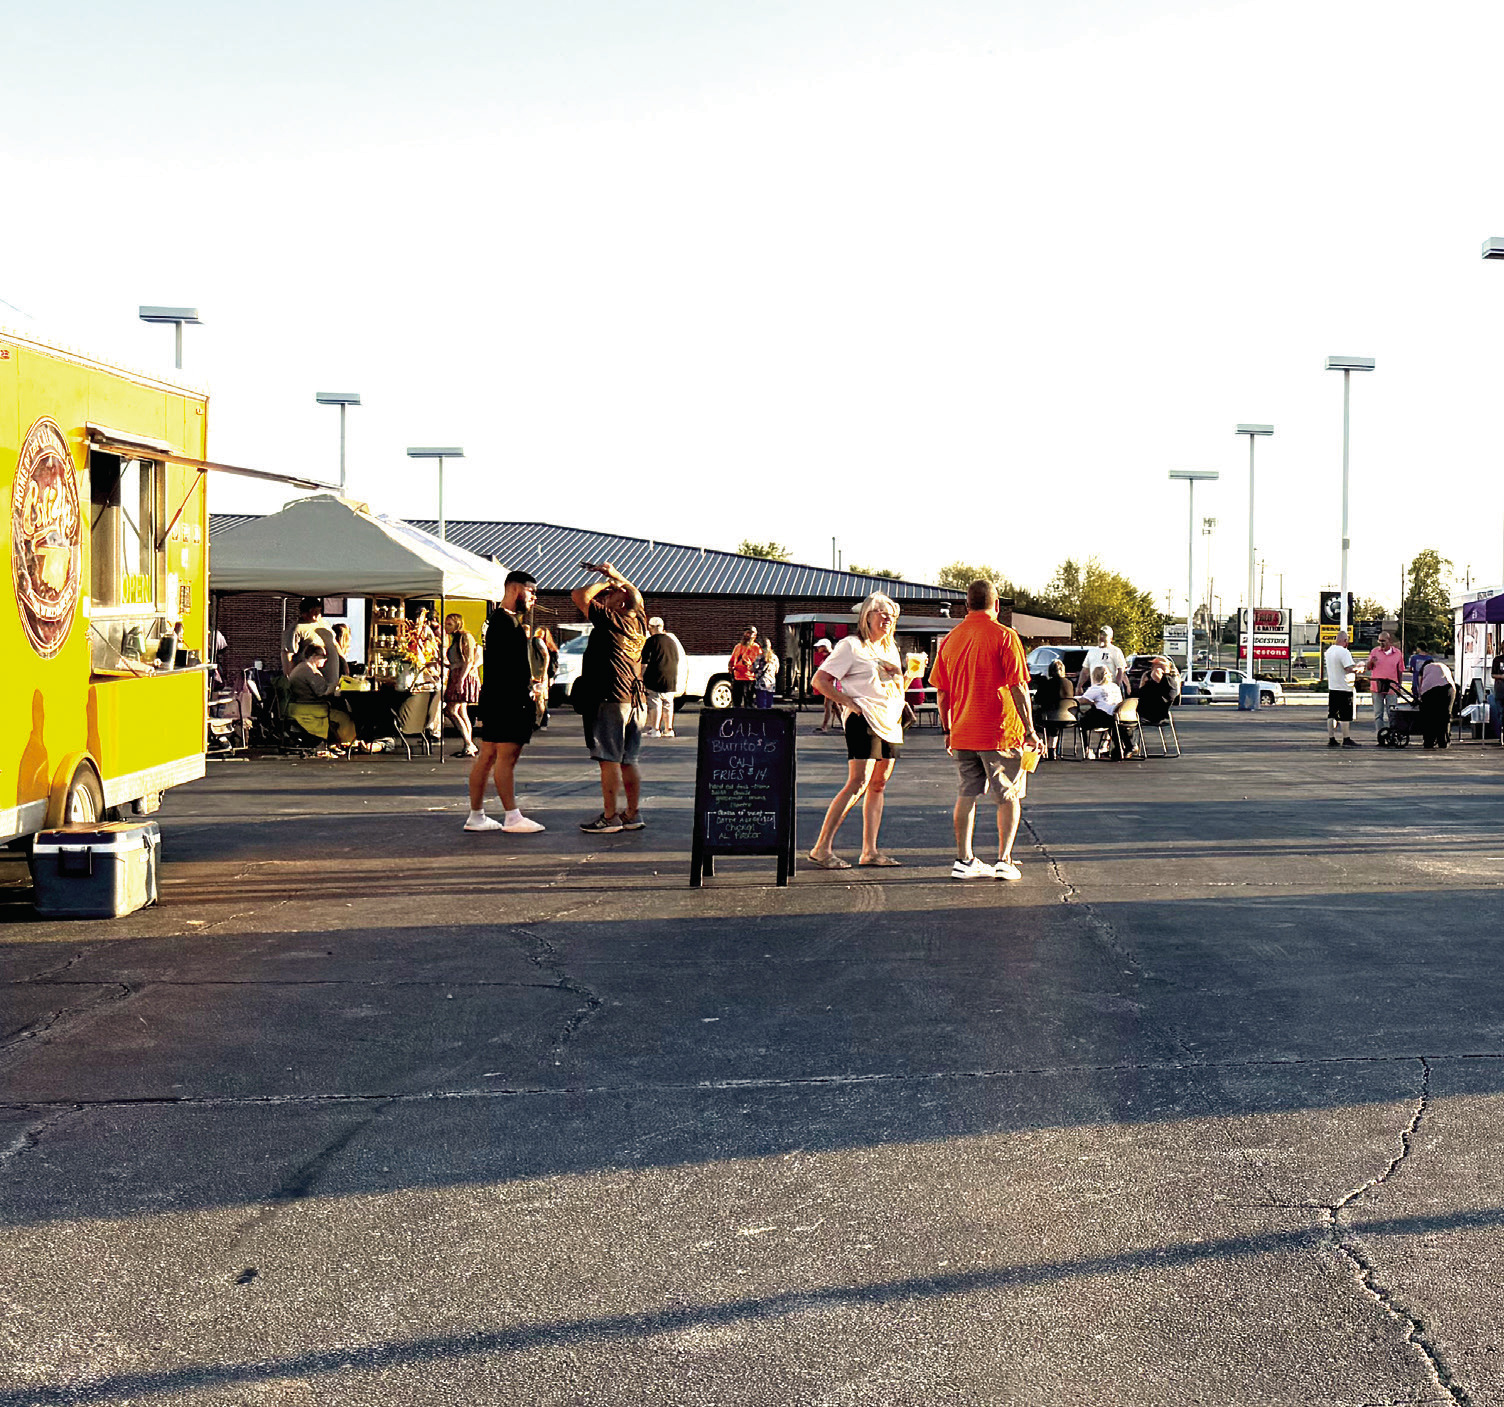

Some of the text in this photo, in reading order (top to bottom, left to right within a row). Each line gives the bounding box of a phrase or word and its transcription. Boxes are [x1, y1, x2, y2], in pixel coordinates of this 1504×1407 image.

[122, 573, 151, 603] OPEN
[1242, 648, 1287, 656] Frestone
[720, 718, 767, 738] CALI
[713, 769, 744, 780] FRIES
